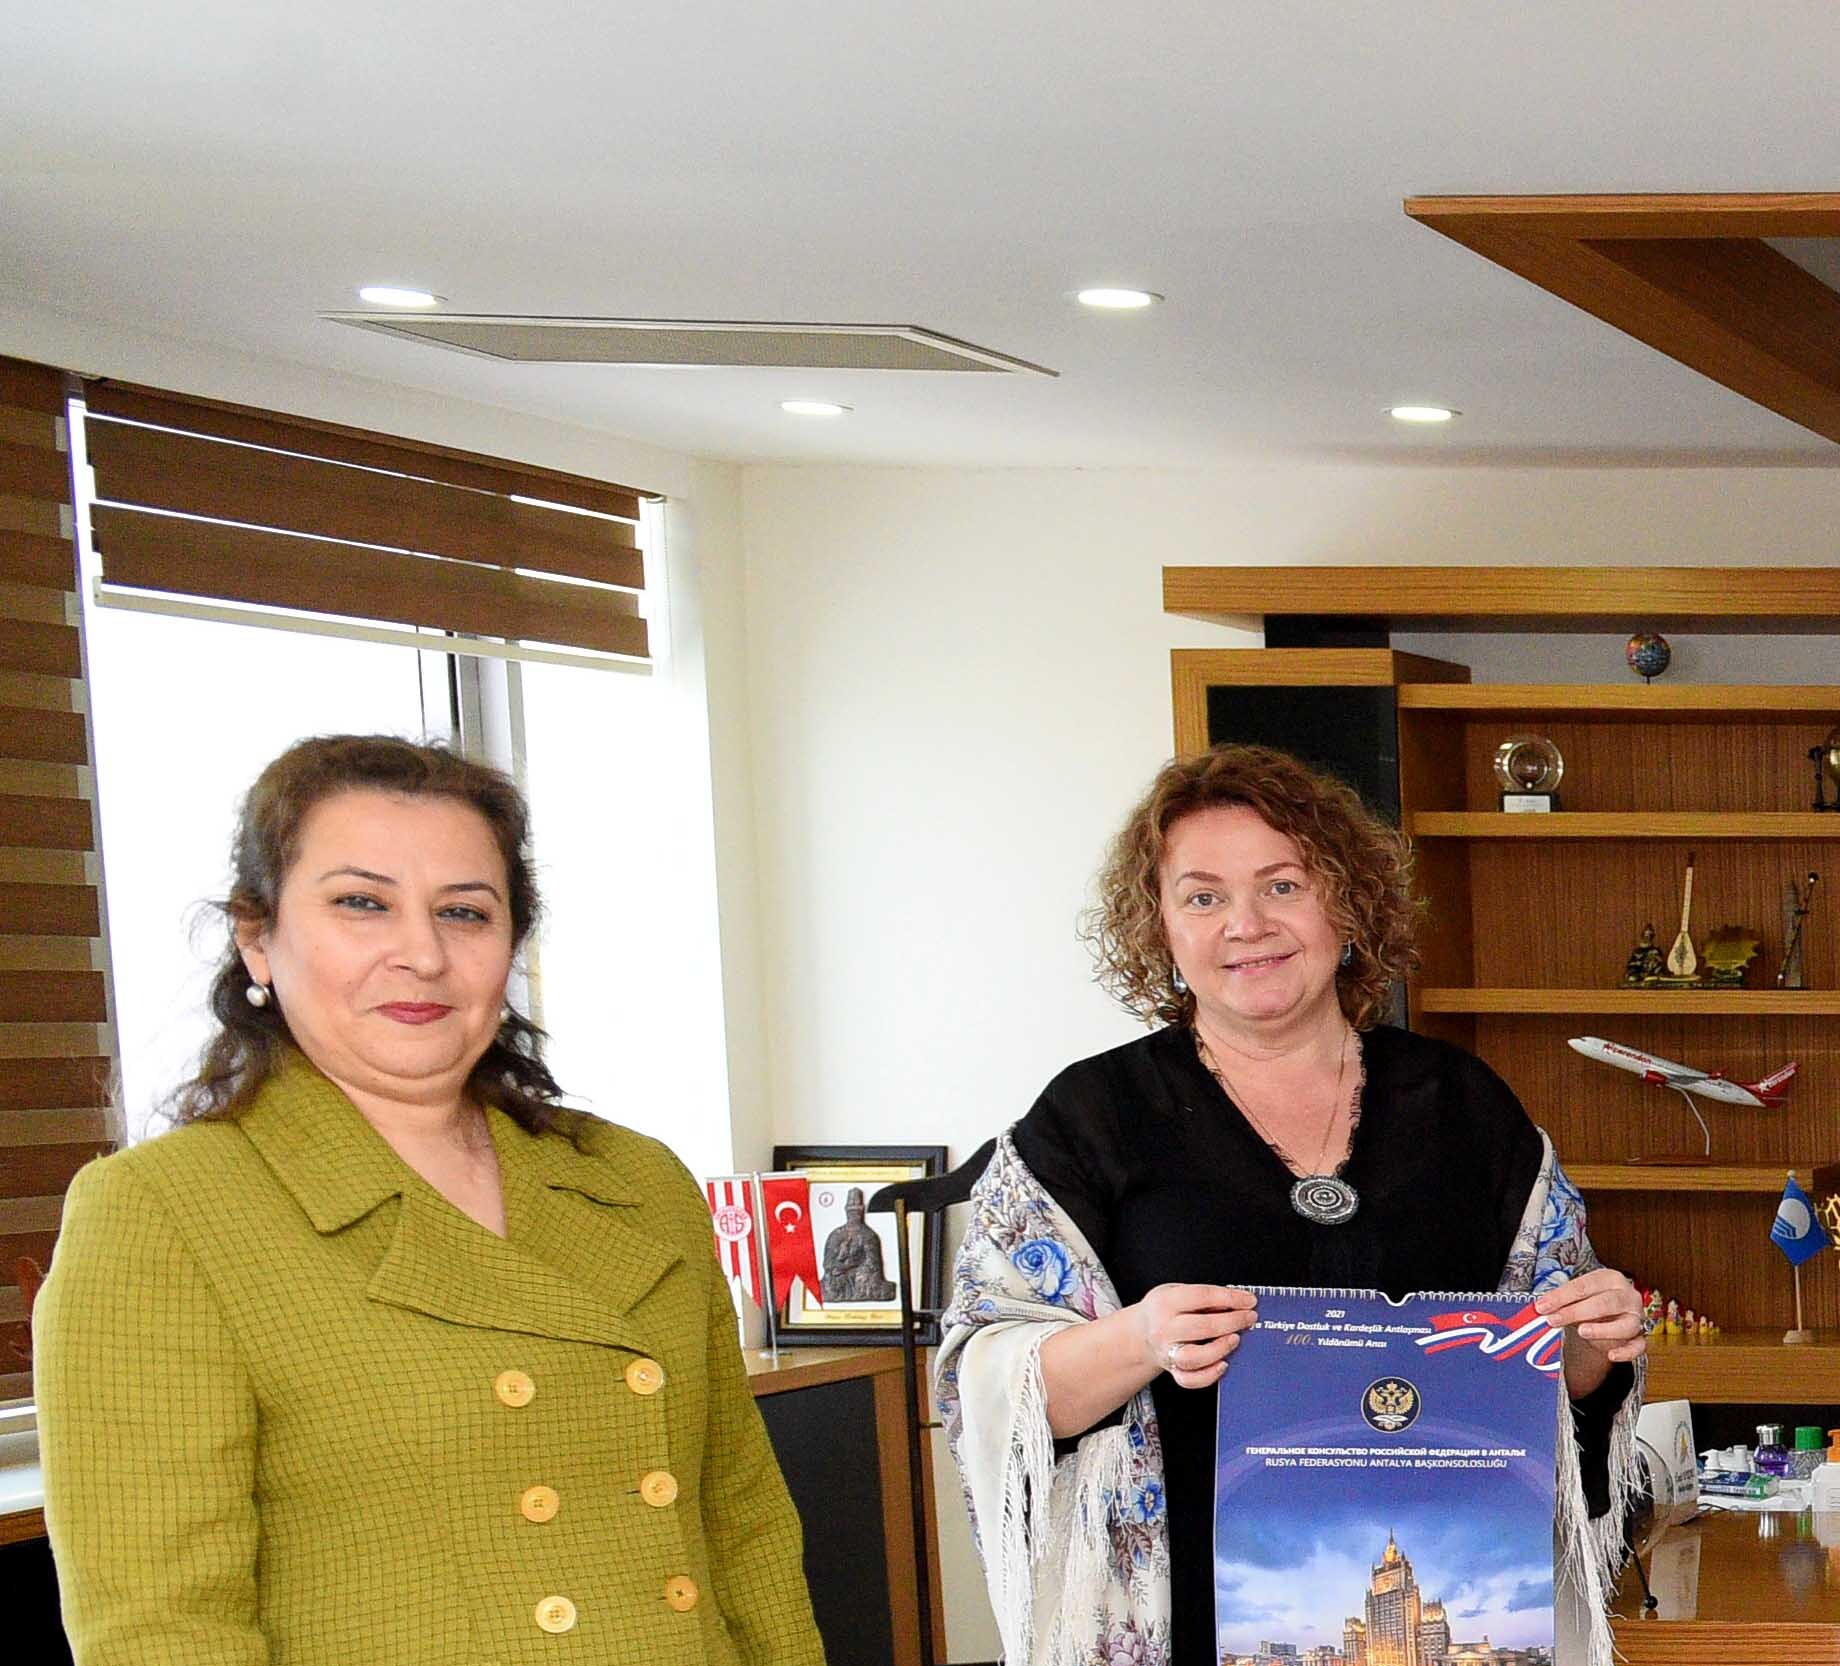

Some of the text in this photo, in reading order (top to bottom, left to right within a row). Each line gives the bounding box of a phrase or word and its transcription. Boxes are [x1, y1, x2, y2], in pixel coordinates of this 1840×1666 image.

[1264, 1320, 1296, 1331] Türkiye
[1265, 1457, 1508, 1470] RUSYA FEDERASYONU ANTALYA BAŞKONSOLOSLUĞU
